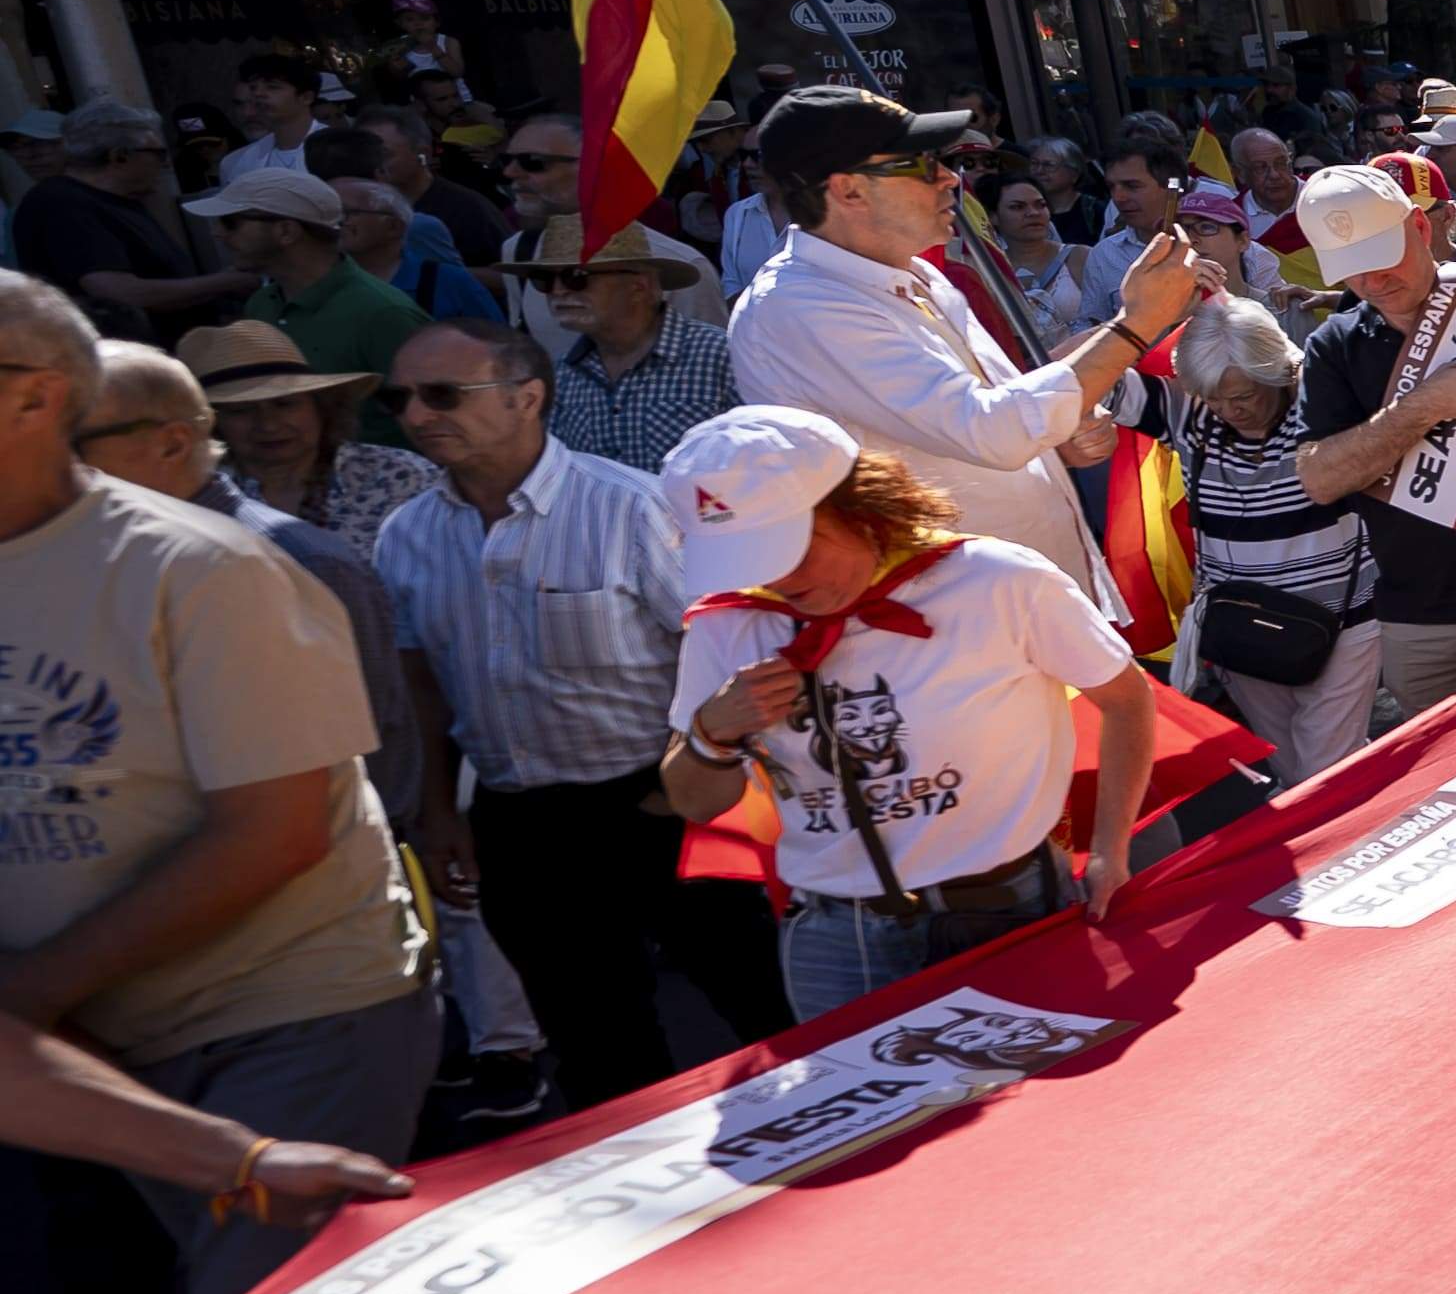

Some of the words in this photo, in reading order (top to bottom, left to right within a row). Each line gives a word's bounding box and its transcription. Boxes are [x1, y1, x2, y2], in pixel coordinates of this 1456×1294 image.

[801, 8, 888, 24] AURIANA
[1408, 451, 1447, 504] SE
[869, 791, 960, 825] ESTA
[1347, 834, 1394, 877] POR
[1332, 891, 1394, 918] SE
[706, 1079, 932, 1157] FIESTA
[357, 1220, 451, 1287] POR
